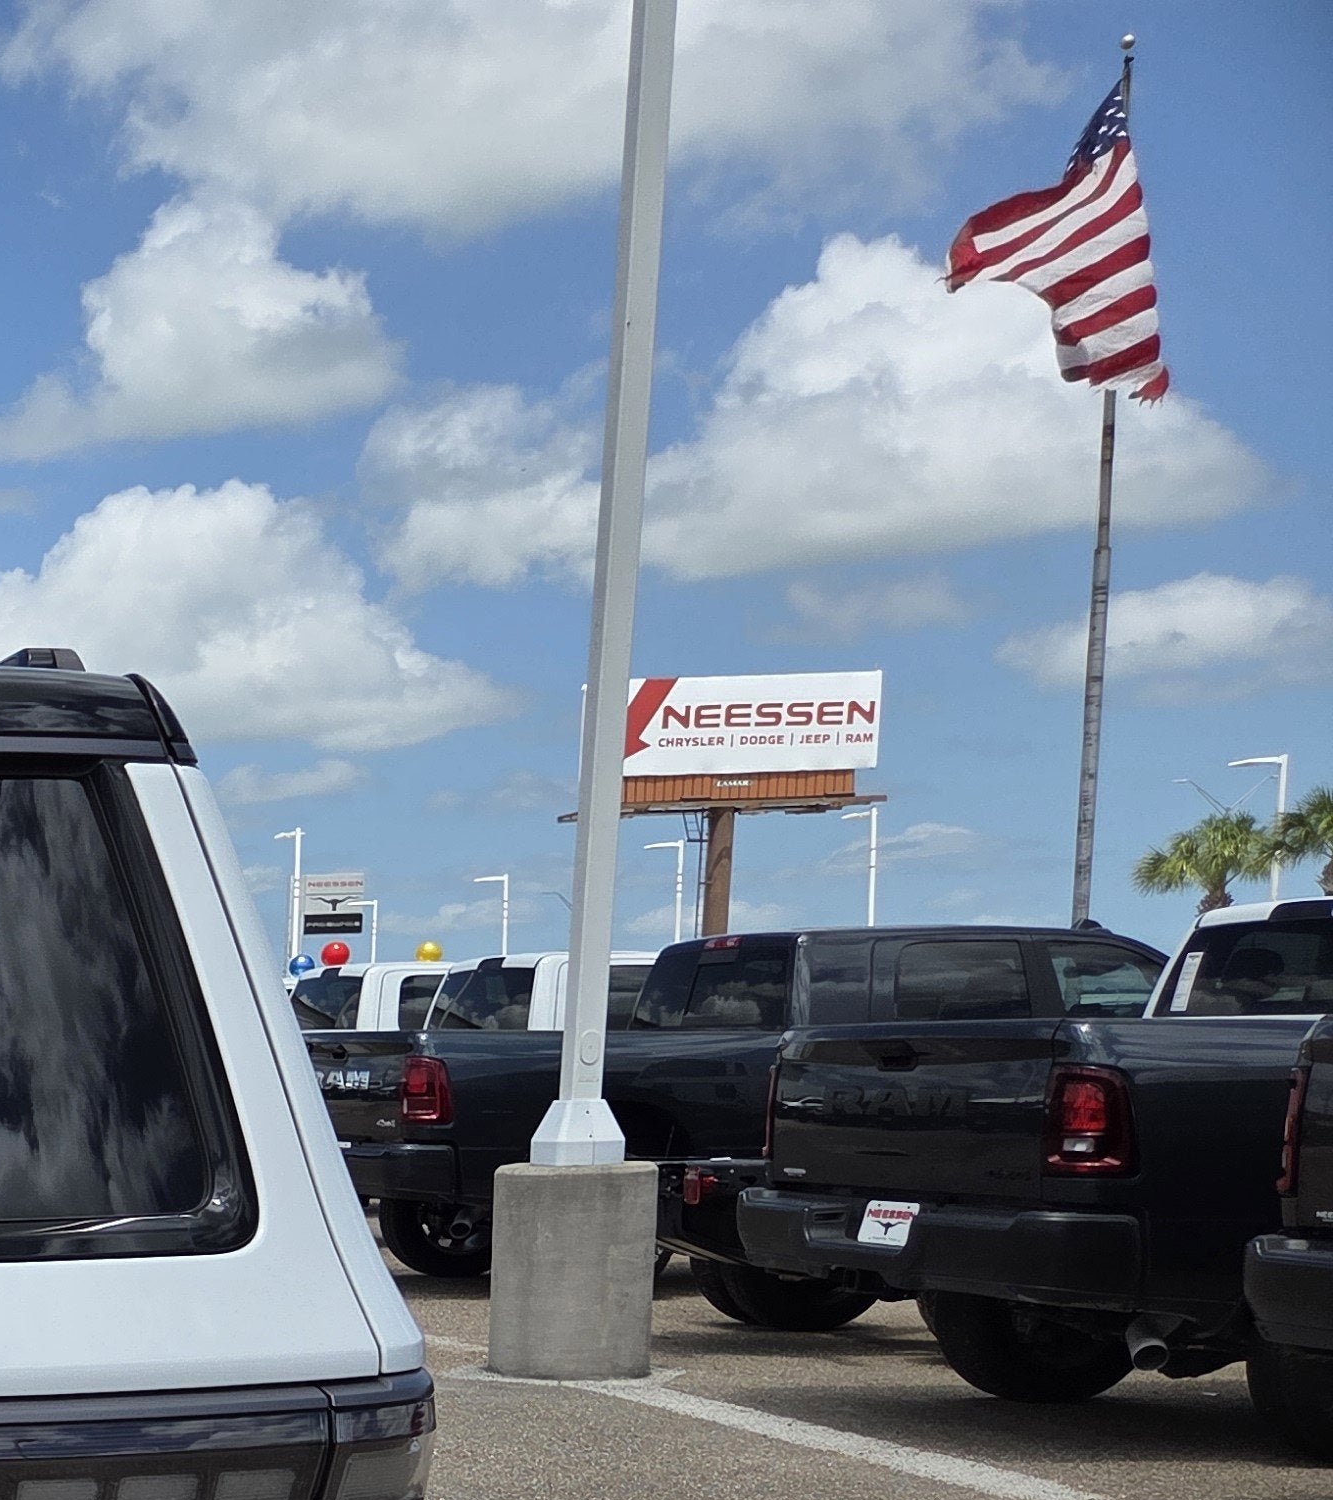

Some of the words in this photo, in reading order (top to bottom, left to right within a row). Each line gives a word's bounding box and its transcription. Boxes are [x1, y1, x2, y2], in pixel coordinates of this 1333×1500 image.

[661, 700, 876, 730] NEESSEN
[657, 736, 724, 748] CHRYSLER
[739, 734, 785, 746] DODGE
[799, 733, 831, 744] JEEP
[845, 732, 874, 744] RAM
